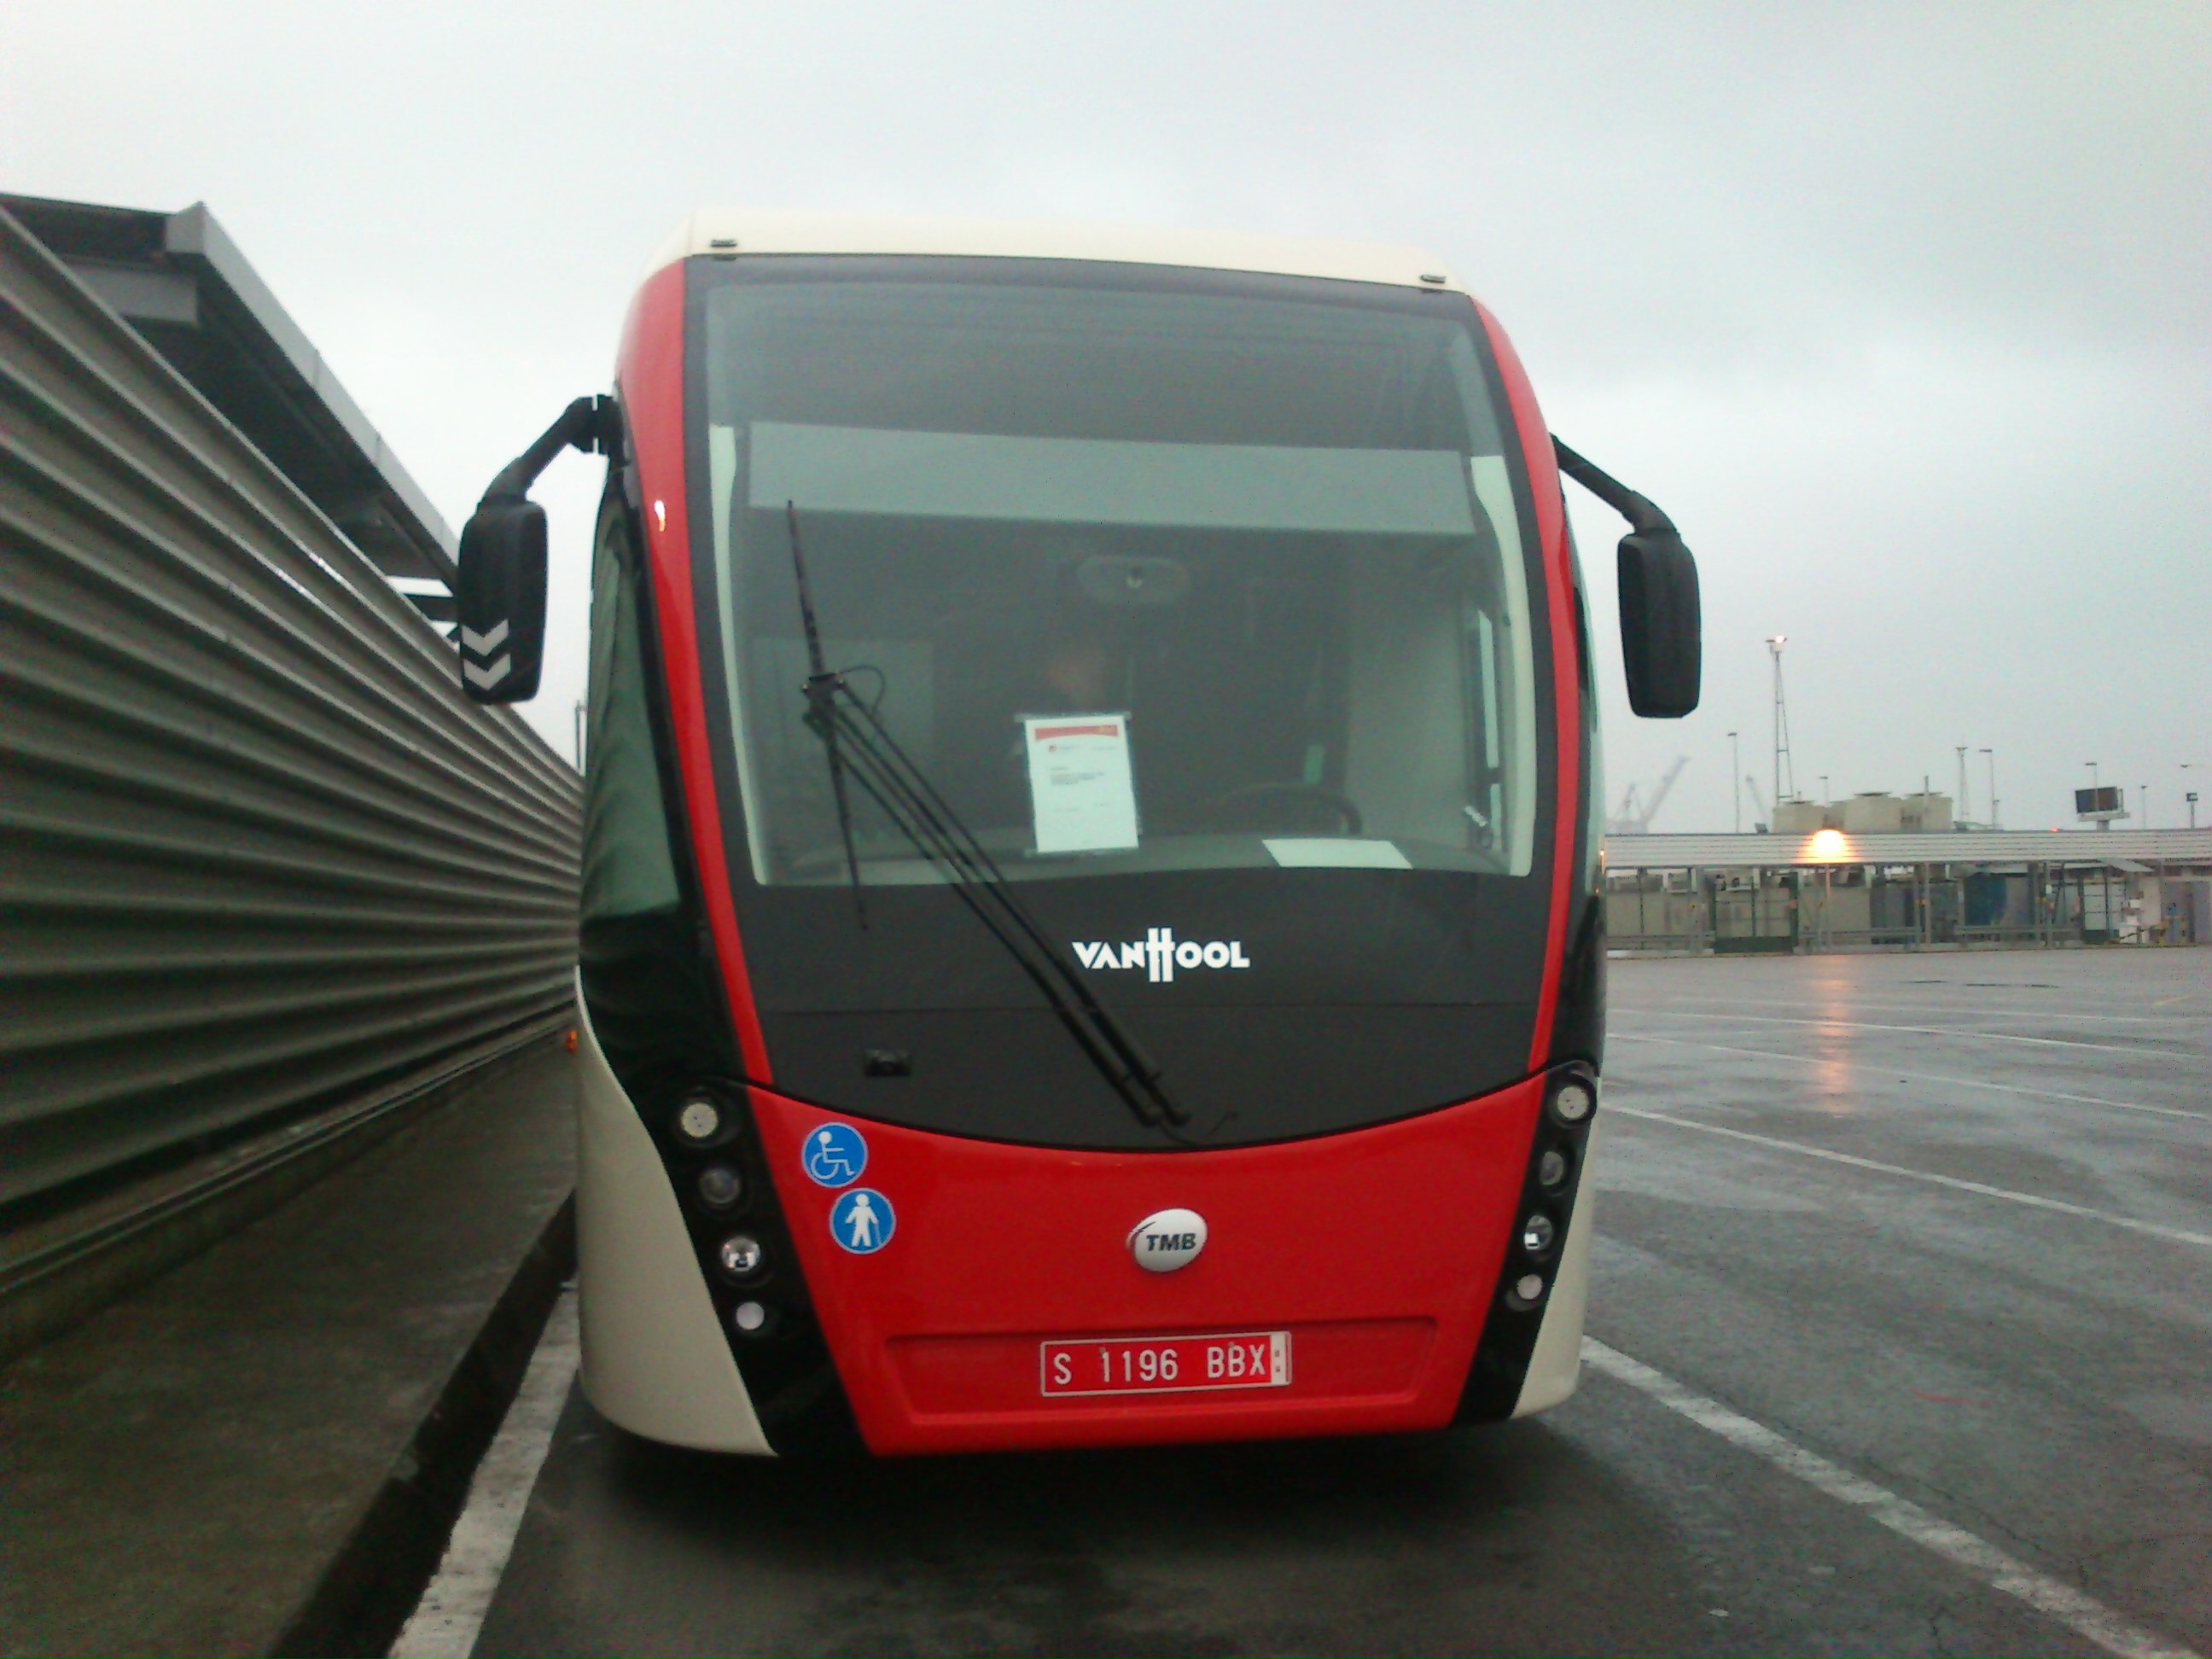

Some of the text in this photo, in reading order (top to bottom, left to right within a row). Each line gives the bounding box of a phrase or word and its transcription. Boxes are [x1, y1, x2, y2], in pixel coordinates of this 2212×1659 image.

[1146, 1233, 1196, 1251] TMB
[1053, 1353, 1072, 1384] S
[1102, 1349, 1178, 1382] 1196
[1207, 1344, 1265, 1378] BBX
